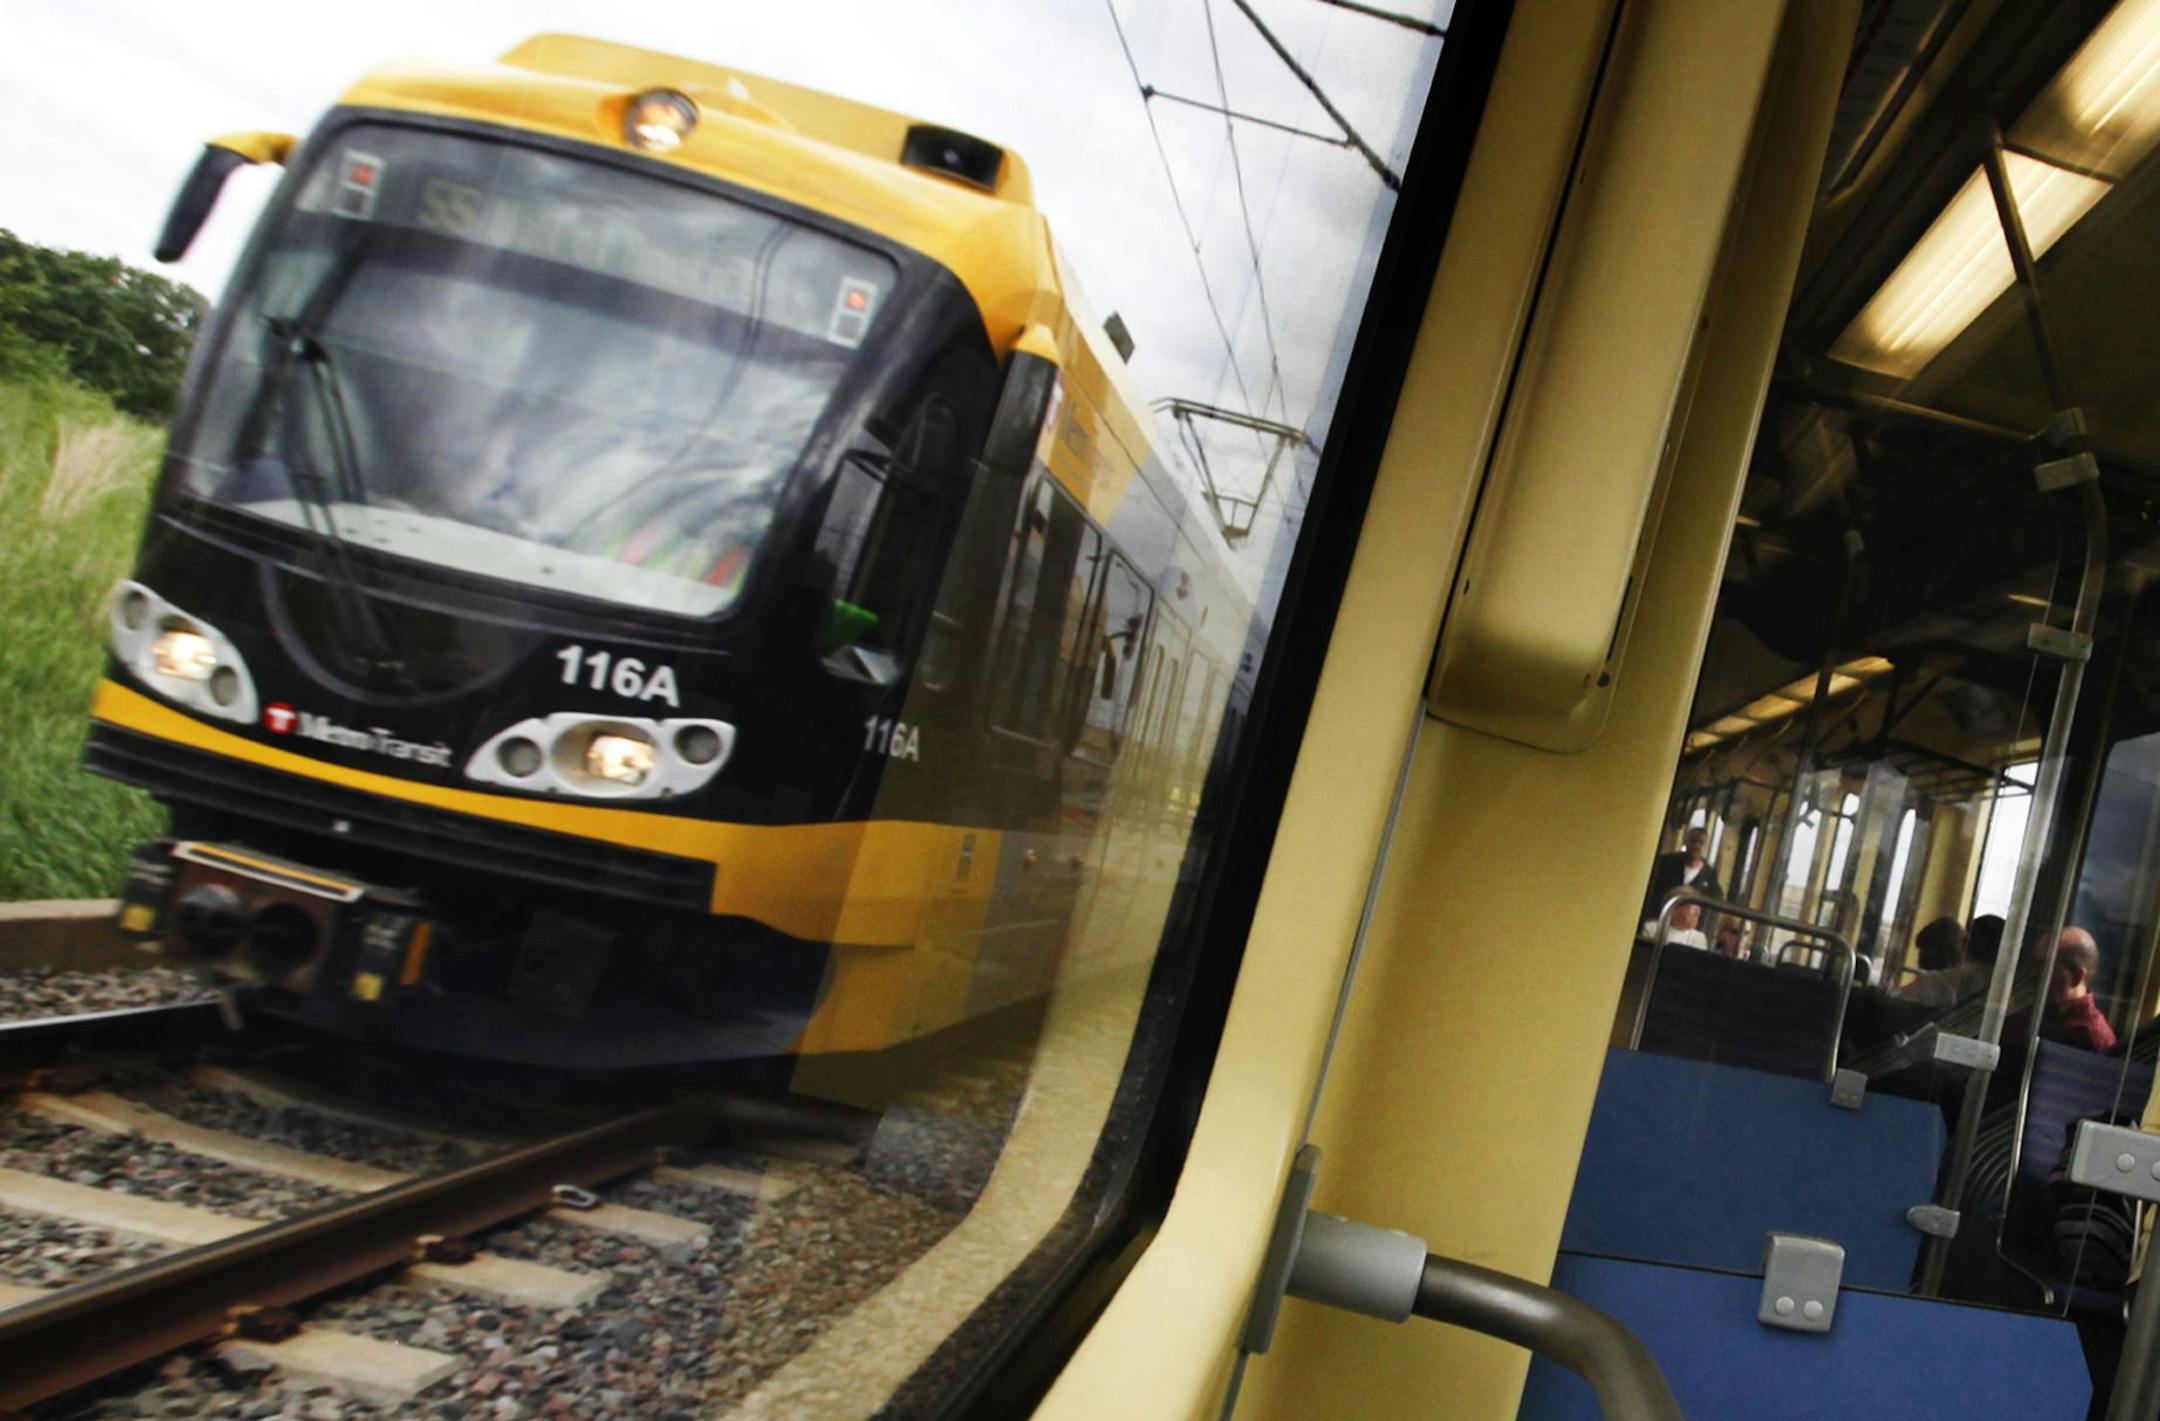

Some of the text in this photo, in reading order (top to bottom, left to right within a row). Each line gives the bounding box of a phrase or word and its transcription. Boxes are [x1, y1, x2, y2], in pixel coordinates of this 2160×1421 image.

[556, 644, 680, 707] 116A
[370, 727, 456, 768] Transit
[863, 715, 919, 762] 116A
